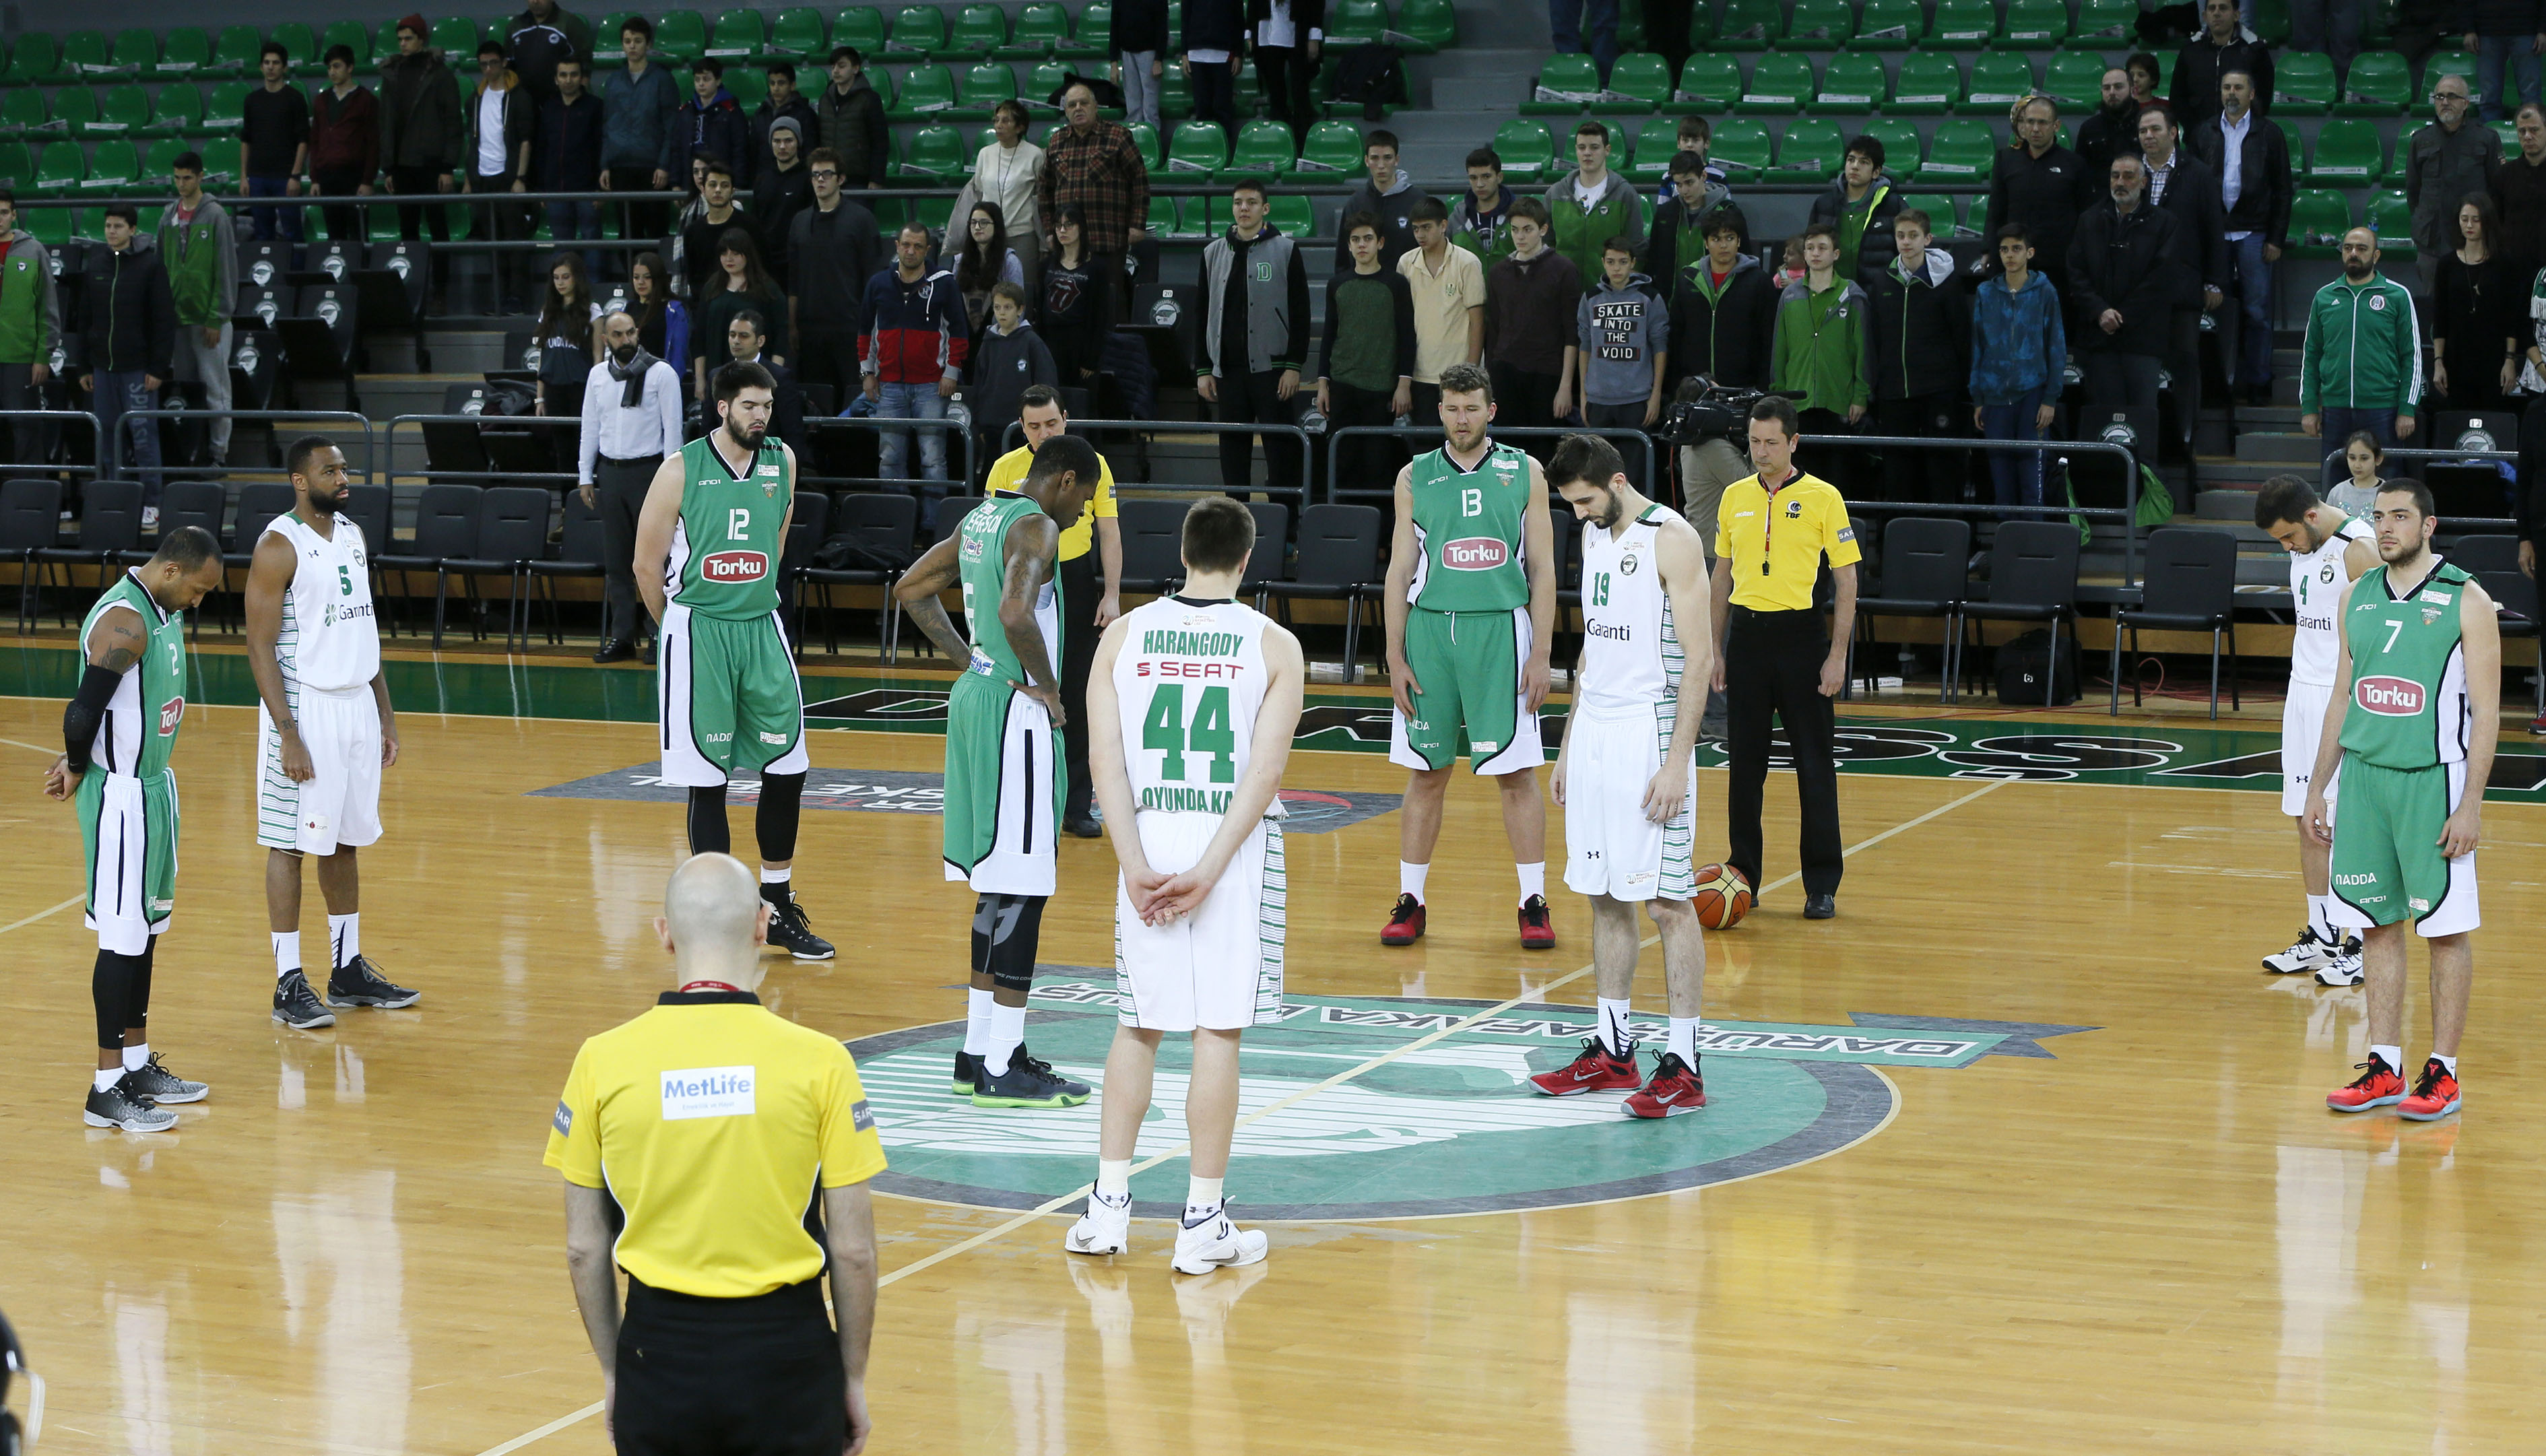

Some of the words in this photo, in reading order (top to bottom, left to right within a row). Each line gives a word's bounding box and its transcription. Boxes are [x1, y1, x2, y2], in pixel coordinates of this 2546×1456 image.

[1257, 262, 1272, 282] D
[1598, 305, 1641, 317] SKATE
[1604, 319, 1631, 331] INTO
[1606, 332, 1626, 342] THE
[1602, 347, 1633, 358] VOID
[1462, 488, 1482, 517] 13
[727, 508, 750, 540] 12
[1839, 529, 1855, 539] SAR
[1449, 545, 1499, 563] Torku
[709, 558, 760, 576] Torku
[338, 565, 353, 596] 5
[1593, 572, 1610, 606] 19
[2299, 575, 2308, 605] 4
[1587, 618, 1630, 641] Garanti
[2382, 620, 2403, 653] 7
[1143, 630, 1243, 657] HARANGODY
[169, 642, 179, 676] 2
[1161, 662, 1244, 680] SEAT
[2363, 684, 2417, 707] Torku
[706, 731, 734, 743] NADD
[1143, 684, 1235, 784] 44
[1142, 787, 1208, 812] OYUNDA
[1212, 791, 1233, 814] KA
[2336, 872, 2377, 886] NADDA
[664, 1074, 751, 1098] MetLife
[854, 1106, 872, 1123] SAR
